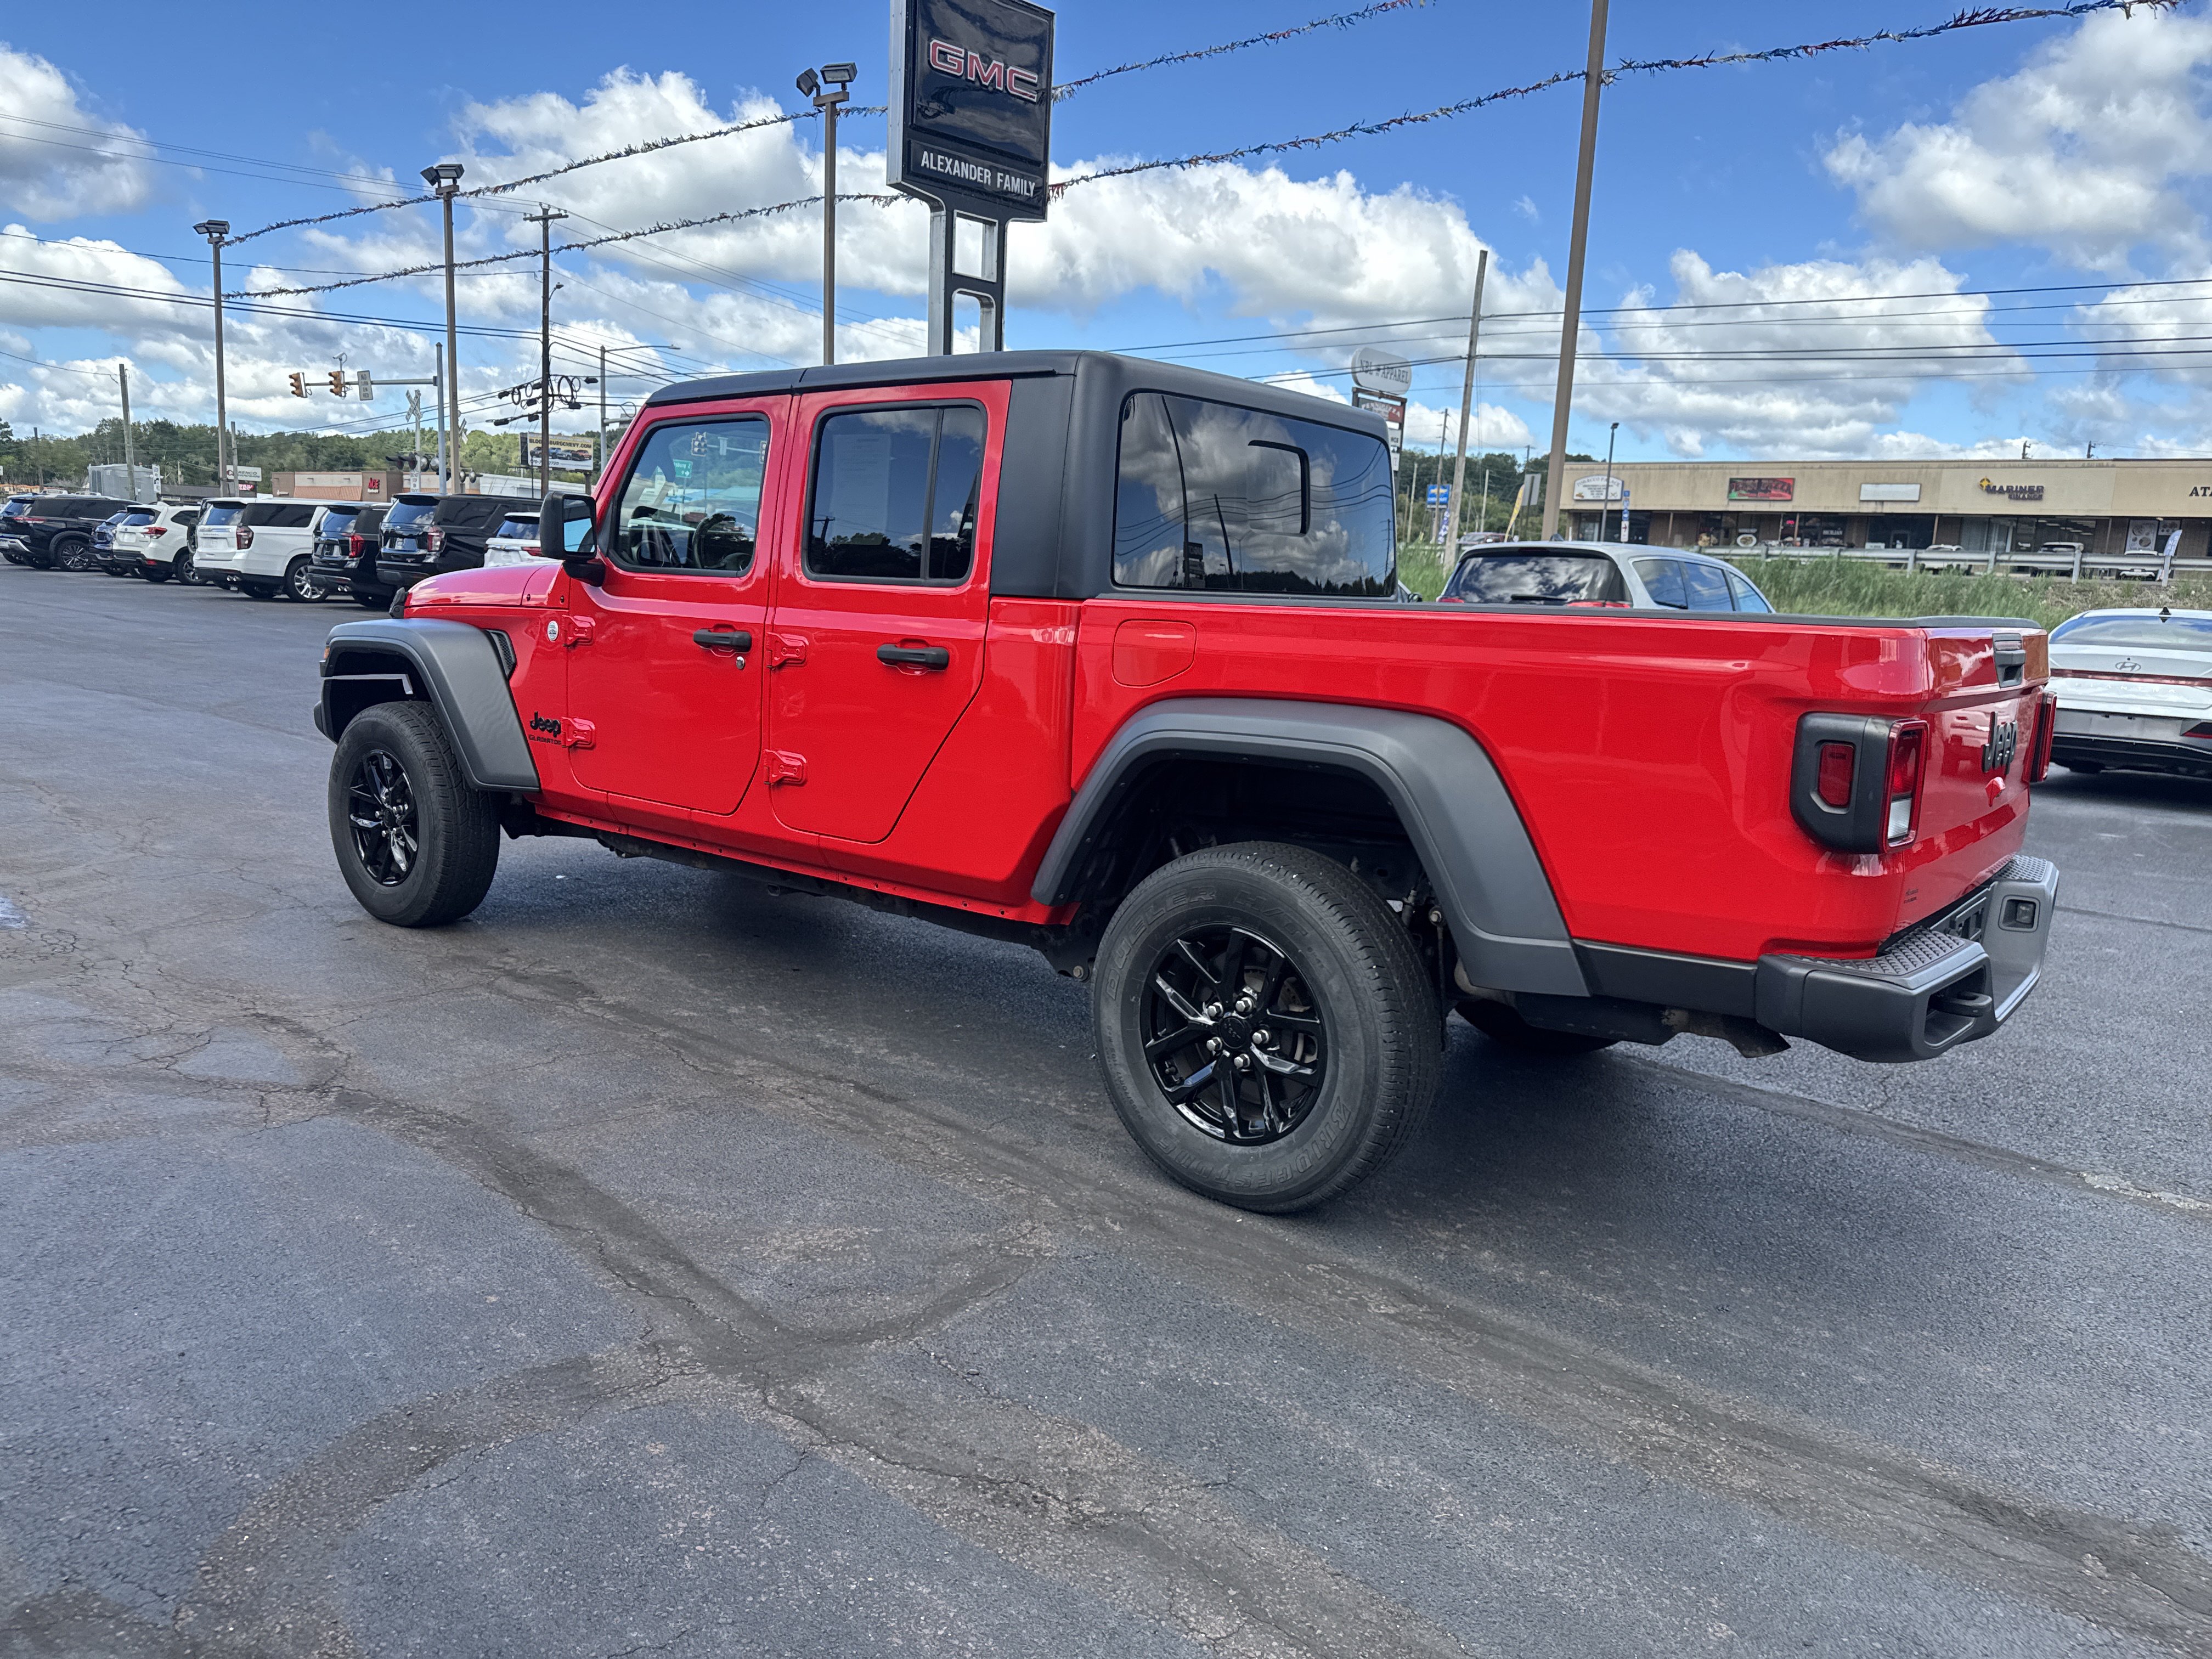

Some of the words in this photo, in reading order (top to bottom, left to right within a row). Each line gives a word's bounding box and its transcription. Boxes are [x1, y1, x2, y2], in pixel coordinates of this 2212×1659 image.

[930, 39, 1038, 103] GMC
[921, 151, 991, 186] ALEXANDER
[997, 172, 1036, 198] FAMILY
[1381, 366, 1409, 384] APPAREL
[1985, 486, 2045, 494] MARINER
[529, 734, 562, 745] GLADIATOR
[530, 711, 562, 738] Jeep
[1981, 711, 2018, 776] Jeep
[1106, 885, 1216, 1000] DUELER
[1156, 1096, 1352, 1187] BRIDGESTONE
